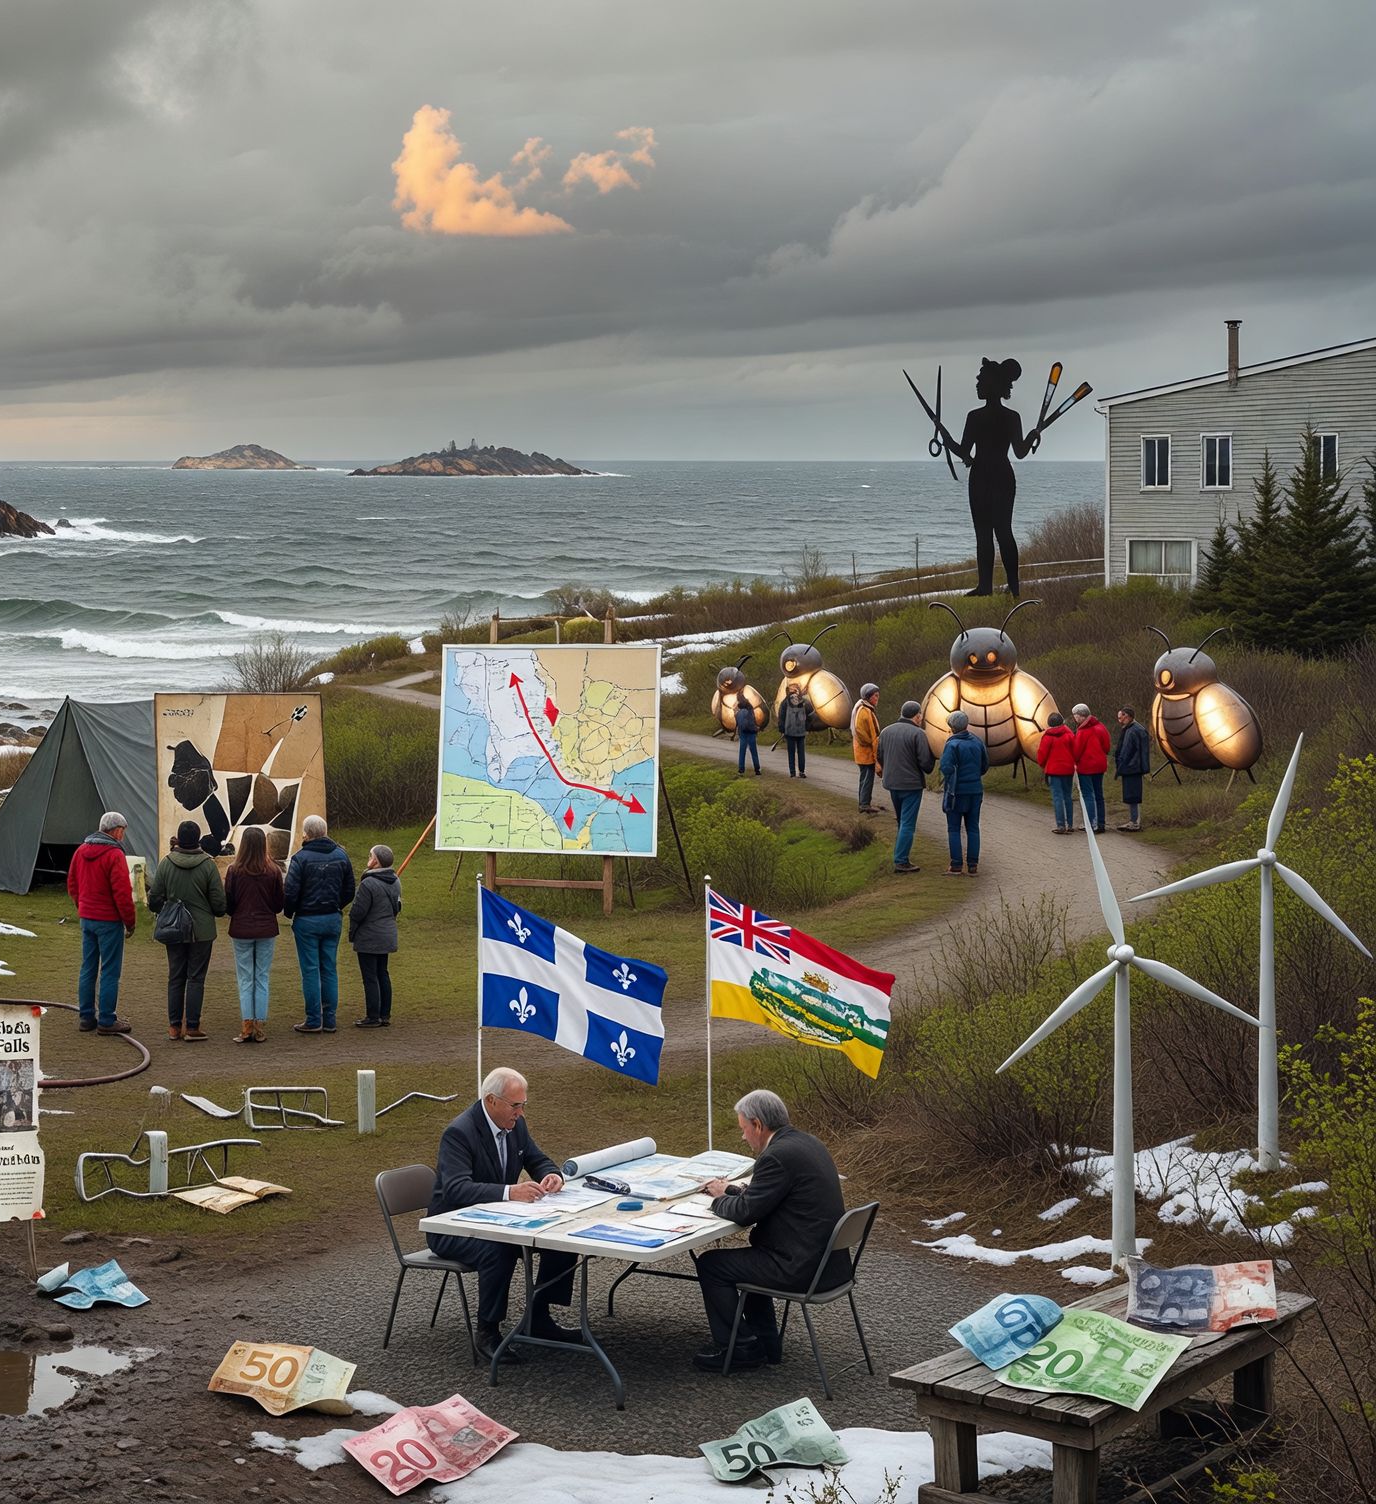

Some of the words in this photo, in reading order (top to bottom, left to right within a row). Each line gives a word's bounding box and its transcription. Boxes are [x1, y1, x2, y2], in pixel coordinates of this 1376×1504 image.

[239, 1350, 300, 1388] 50
[369, 1438, 438, 1487] 20
[720, 1441, 778, 1474] 50
